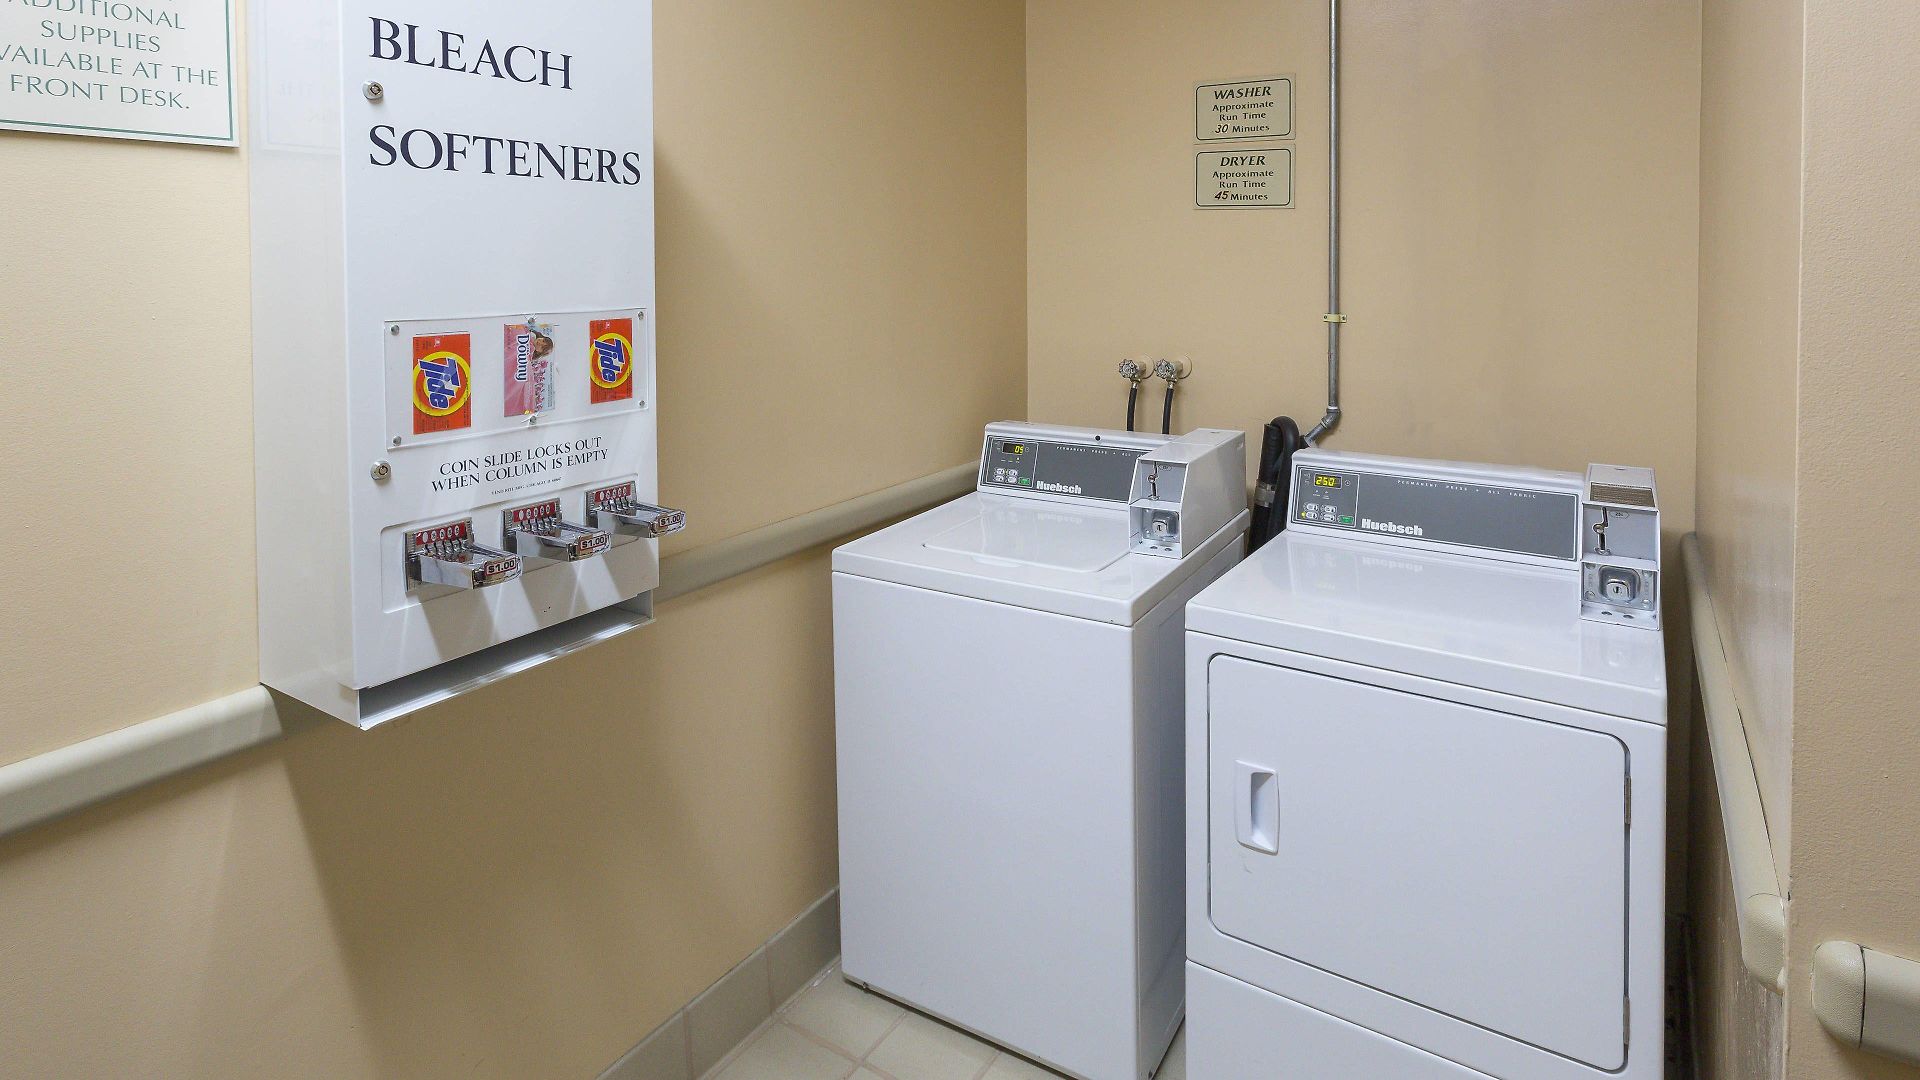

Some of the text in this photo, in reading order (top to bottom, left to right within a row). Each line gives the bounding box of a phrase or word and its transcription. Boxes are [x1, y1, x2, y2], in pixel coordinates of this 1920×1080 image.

[41, 20, 160, 52] SUPPLIES
[368, 16, 573, 91] BLEACH
[132, 61, 163, 79] AT
[171, 65, 218, 86] THE
[10, 74, 190, 110] FRONT DESK.
[1214, 86, 1271, 100] WASHER
[1212, 101, 1274, 112] Approximate
[1242, 112, 1267, 120] Time
[1215, 124, 1270, 134] 30 Minutes
[369, 124, 641, 186] SOFTENERS
[1220, 155, 1266, 167] DRYER
[1212, 170, 1274, 180] Approximate
[1242, 180, 1266, 188] Time
[1214, 191, 1229, 200] 45
[515, 334, 530, 382] Downy
[594, 338, 625, 383] Tide
[417, 357, 461, 410] Tide
[440, 436, 602, 476] COIN SLIDE LOCKS OUT
[432, 472, 480, 492] WHEN
[485, 460, 547, 482] COLUMN
[552, 457, 563, 470] IS
[567, 448, 608, 466] EMPTY
[1036, 480, 1082, 494] Huebsch
[1315, 476, 1336, 487] 250
[659, 513, 682, 527] $1.00
[1361, 518, 1423, 536] Huebsch
[580, 537, 605, 550] $1.00
[488, 559, 515, 574] $1.00
